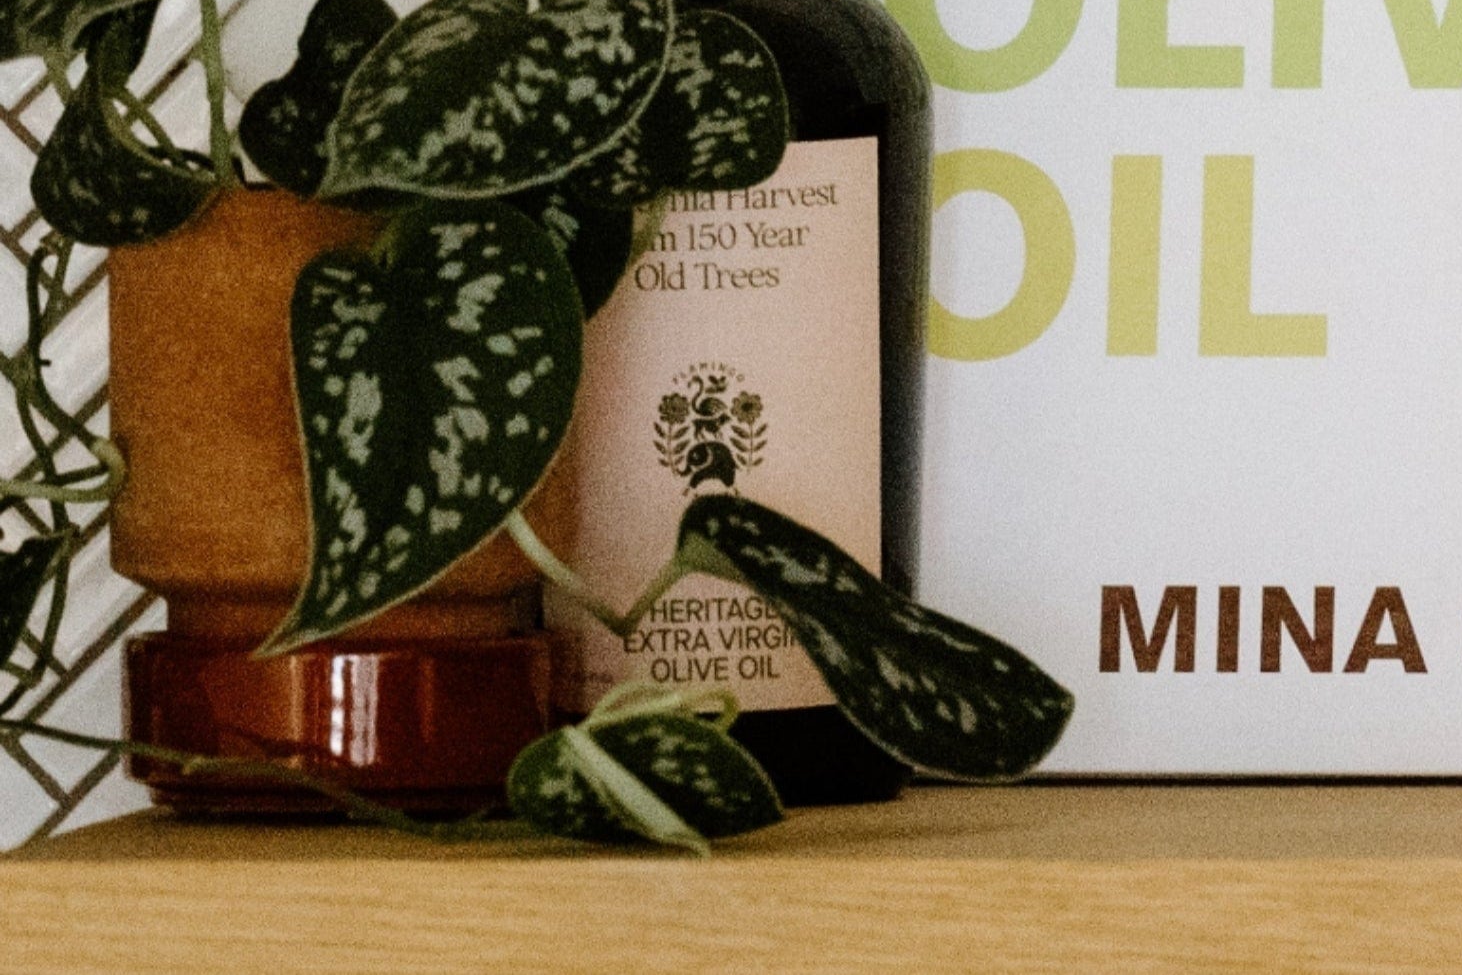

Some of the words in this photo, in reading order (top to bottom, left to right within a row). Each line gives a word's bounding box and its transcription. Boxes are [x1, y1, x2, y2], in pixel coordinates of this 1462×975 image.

[726, 183, 839, 211] Harvest
[687, 223, 737, 251] 150
[745, 222, 810, 249] Year
[926, 148, 1328, 362] OIL
[634, 260, 687, 291] Old
[694, 263, 780, 290] Trees
[623, 628, 711, 654] EXTRA
[717, 625, 796, 652] VIRGI
[1099, 584, 1428, 674] MINA
[651, 655, 729, 684] OLIVE
[738, 654, 781, 681] OIL
